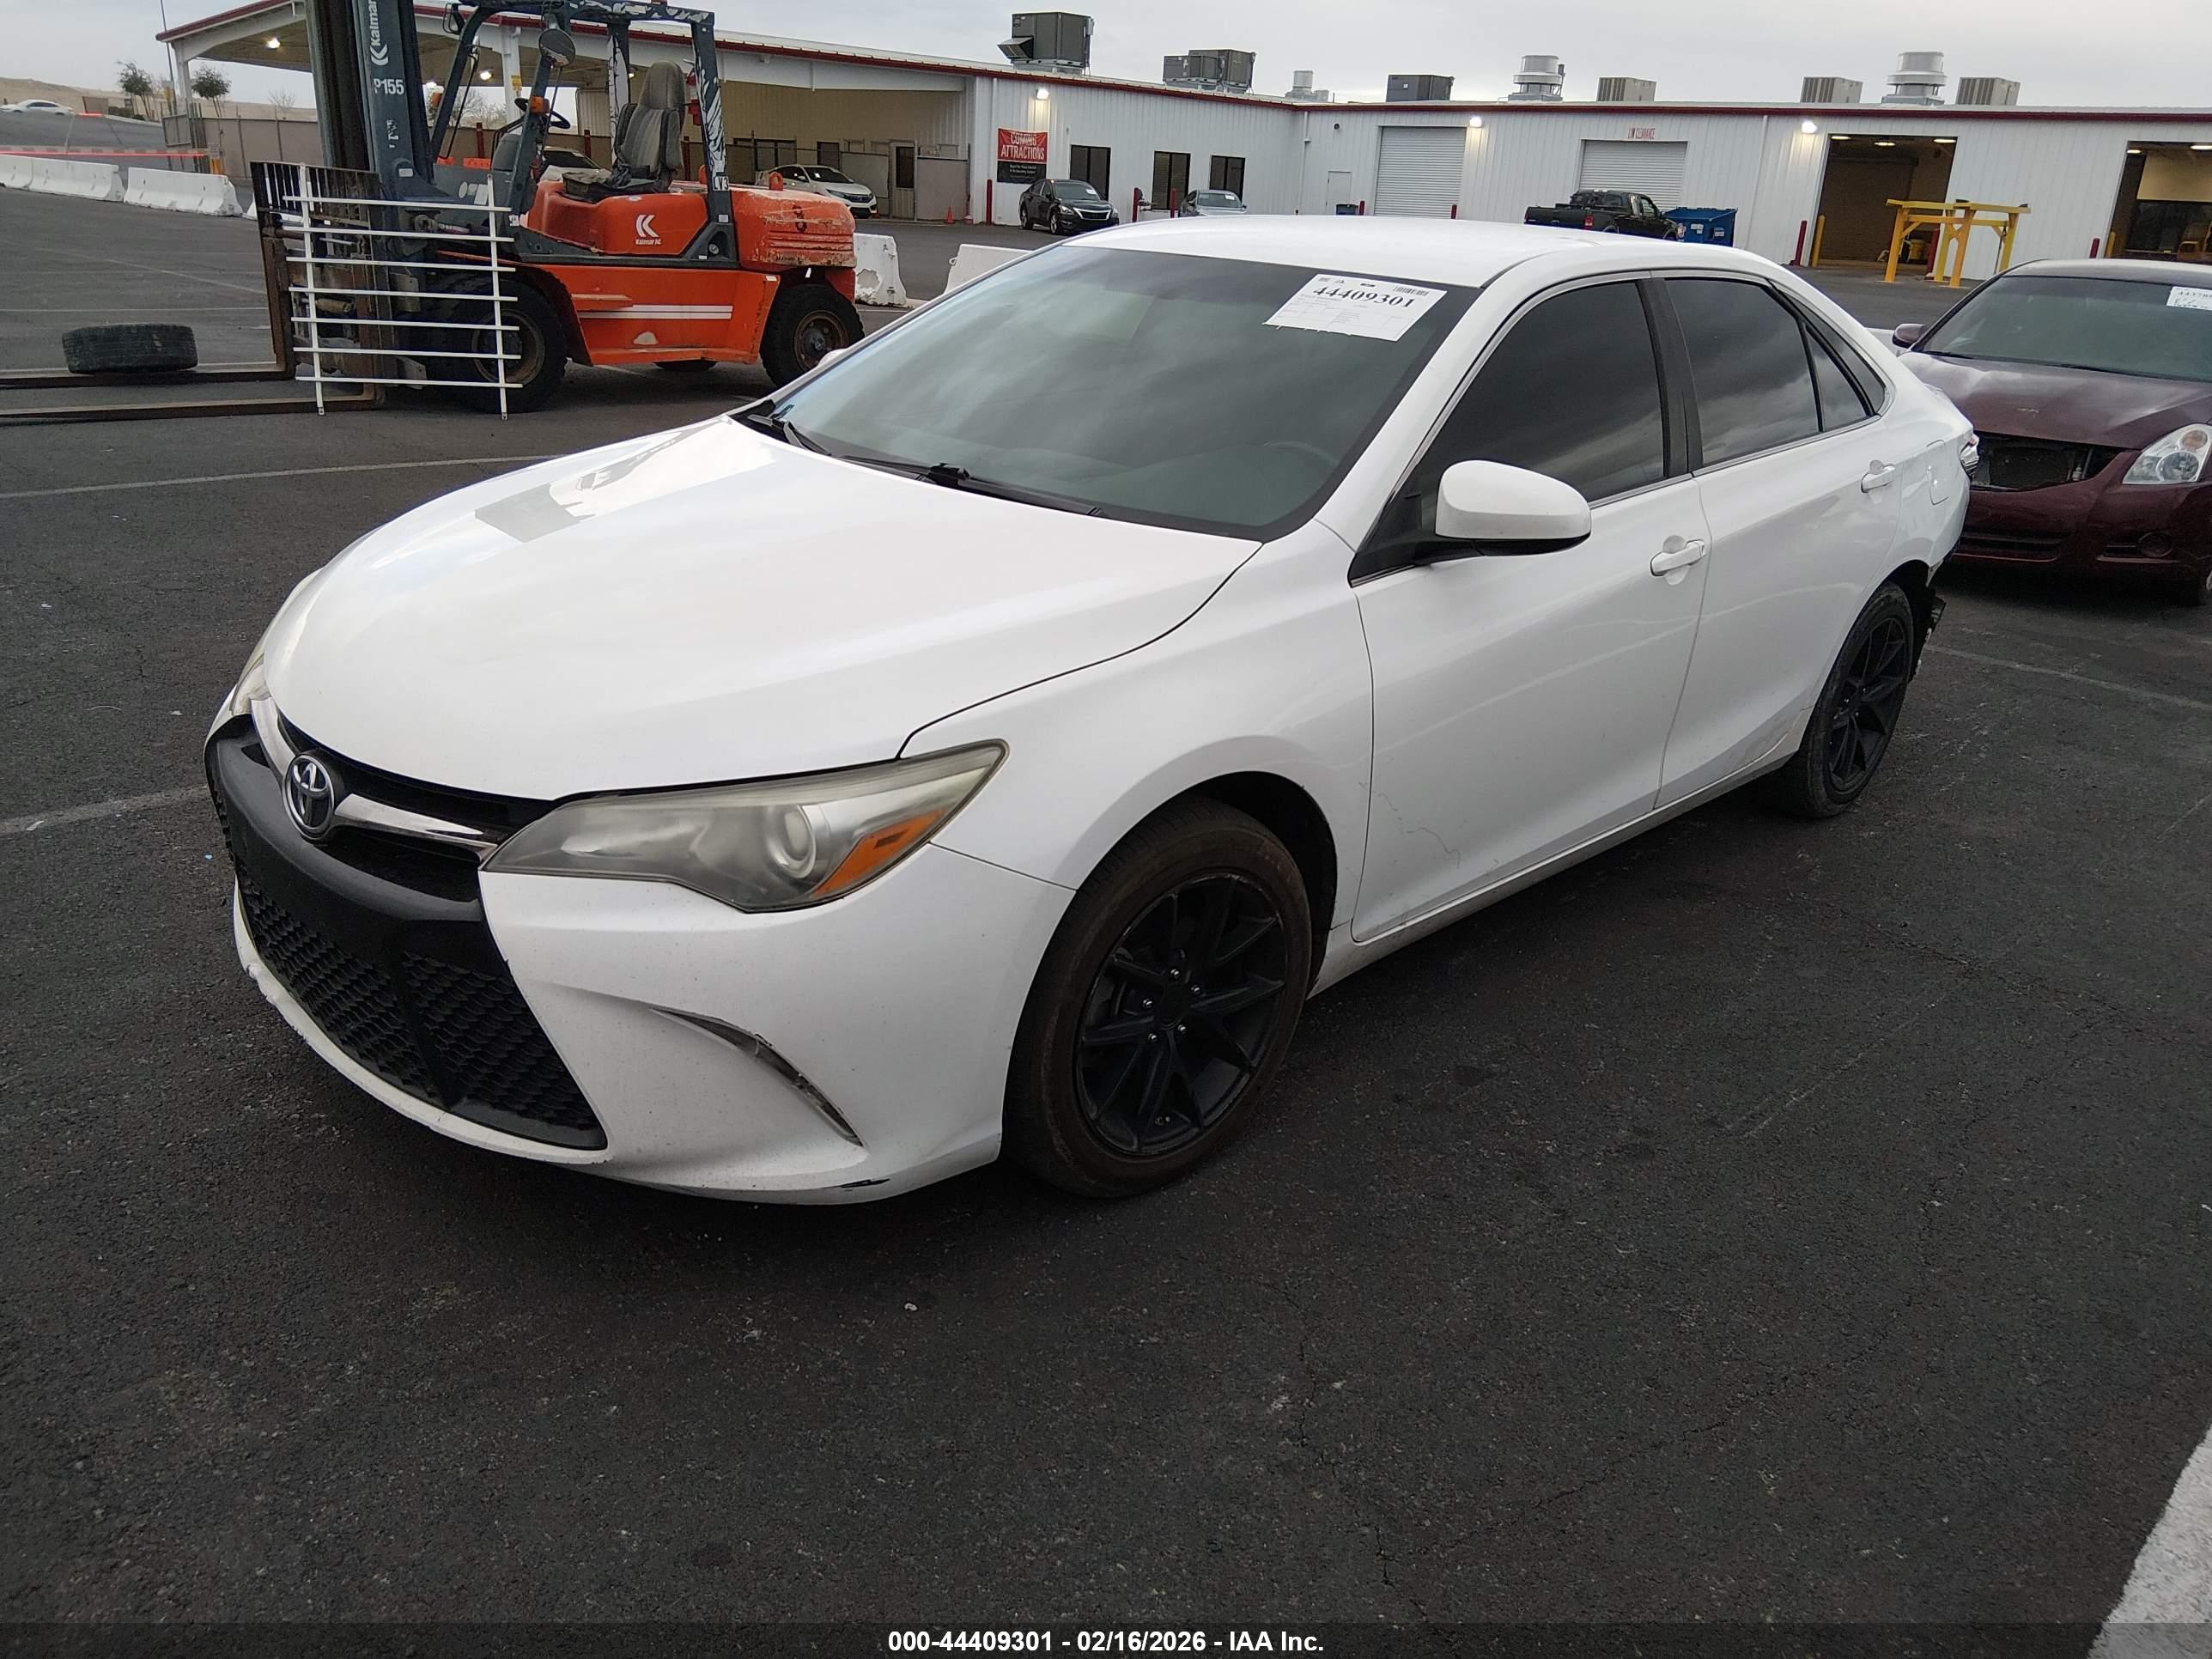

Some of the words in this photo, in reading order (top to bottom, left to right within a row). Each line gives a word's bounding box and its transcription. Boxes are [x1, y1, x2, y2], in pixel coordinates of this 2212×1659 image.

[373, 78, 404, 94] P155
[1010, 132, 1037, 146] COMING
[1000, 144, 1045, 160] ATTRACTIONS
[1313, 286, 1415, 308] 44409301
